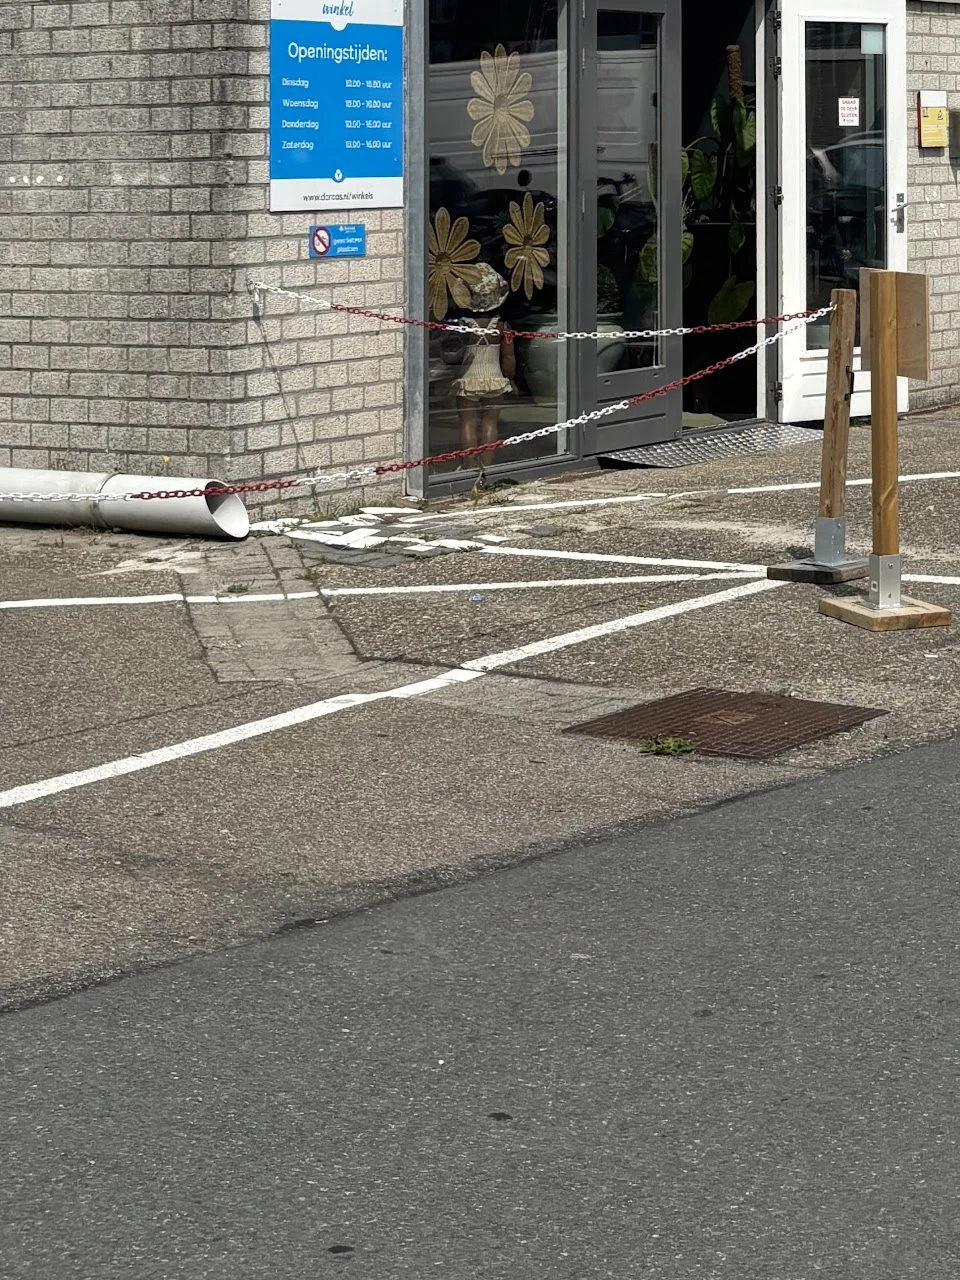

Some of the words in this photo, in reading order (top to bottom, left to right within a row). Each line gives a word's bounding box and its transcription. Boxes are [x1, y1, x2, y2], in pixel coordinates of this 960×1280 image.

[322, 0, 354, 17] winkel
[287, 41, 388, 65] Openingstijden:
[282, 78, 309, 88] Dinsdag
[282, 99, 319, 109] Woensdag
[281, 120, 319, 130] Donderdag
[281, 140, 314, 151] Zaterdag
[382, 141, 392, 149] uur
